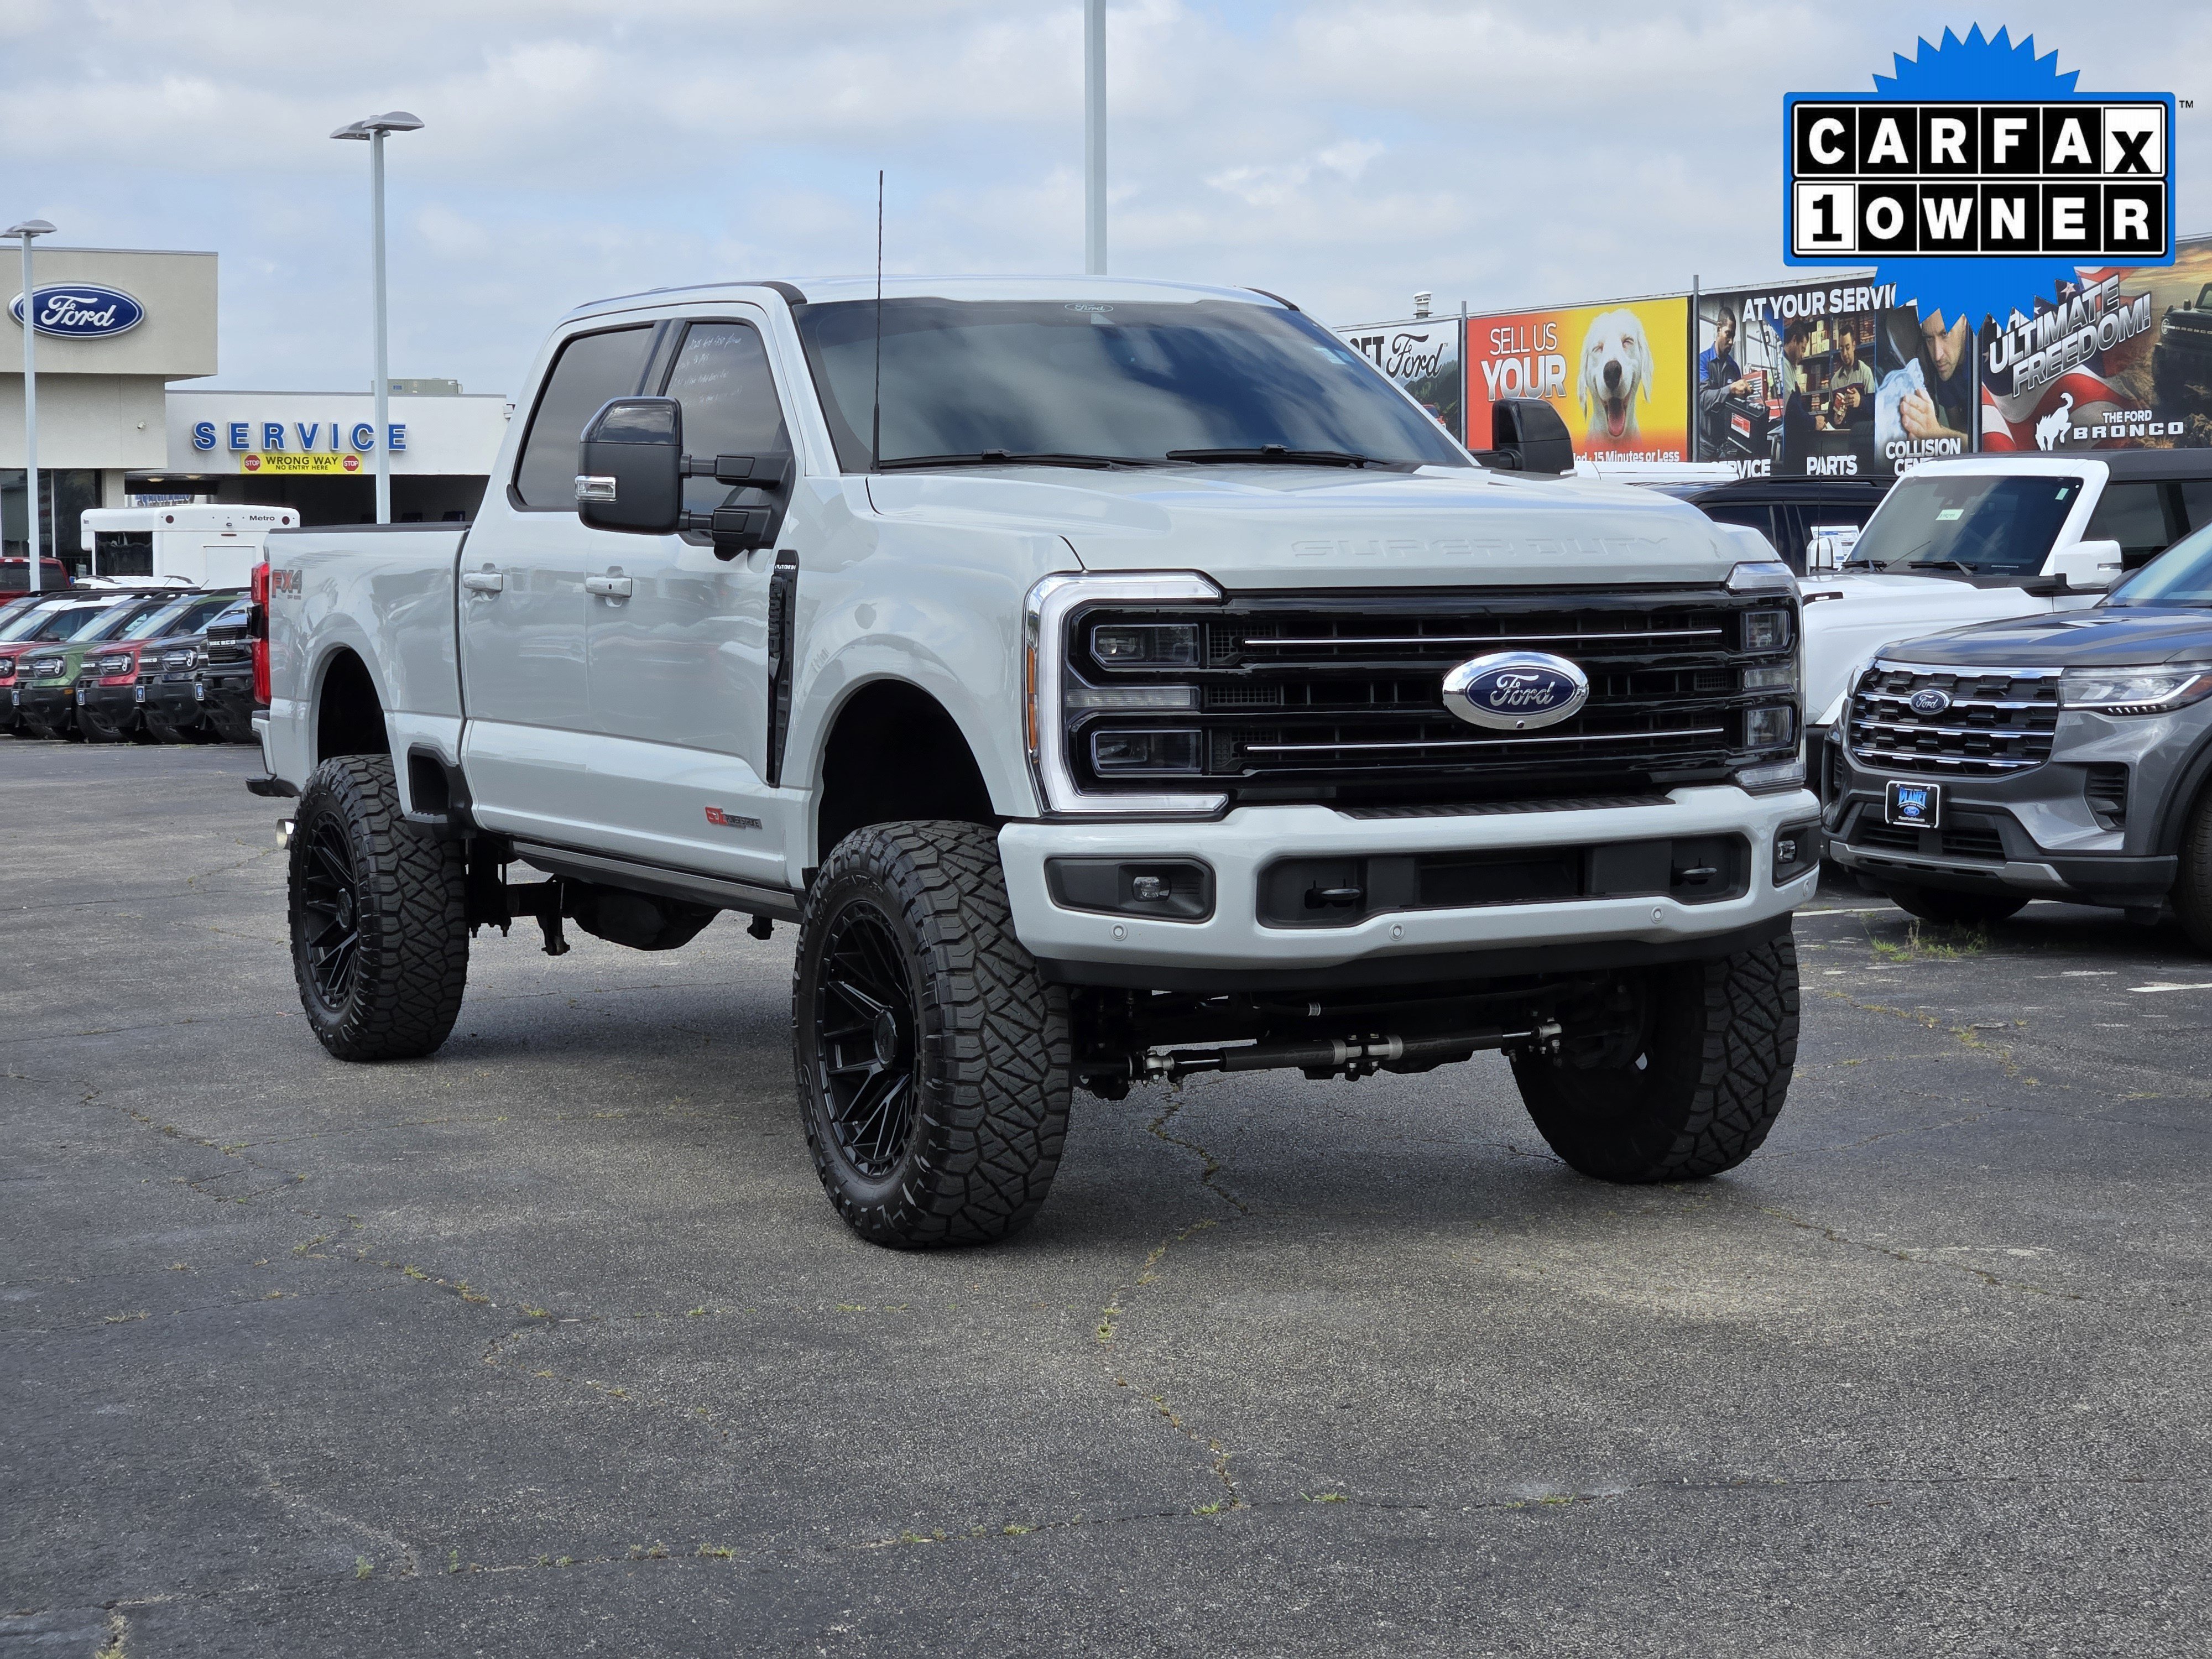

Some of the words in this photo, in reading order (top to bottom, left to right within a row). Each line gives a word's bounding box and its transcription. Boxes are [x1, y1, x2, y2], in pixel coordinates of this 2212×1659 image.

[41, 295, 115, 327] Ford
[1742, 298, 1767, 322] AT
[1770, 291, 1825, 319] YOUR
[1829, 284, 1917, 314] SERVI
[1990, 274, 2119, 374] ULTIMATE
[1490, 326, 1531, 356] SELL
[1533, 322, 1557, 352] US
[2013, 293, 2151, 398] FREEDOM!
[1386, 333, 1444, 379] Ford
[1480, 354, 1567, 401] YOUR
[2103, 411, 2123, 424] THE
[2124, 410, 2152, 422] FORD
[194, 421, 408, 451] SERVICE
[2073, 421, 2184, 440] BRONCO
[265, 456, 310, 465] WRONG
[314, 457, 338, 465] WAY
[1594, 451, 1604, 461] 15
[1605, 450, 1644, 462] Minutes
[1646, 452, 1656, 462] or
[1657, 449, 1680, 462] Less
[1885, 437, 1961, 460] COLLISION
[1712, 458, 1771, 479] VICE
[1807, 455, 1858, 476] PARTS
[1291, 539, 1516, 557] SUPER
[1525, 537, 1670, 555] DUTY
[272, 569, 302, 598] FX4
[1490, 674, 1556, 706] Ford
[1916, 694, 1939, 708] Ford
[1897, 787, 1927, 807] PLANET
